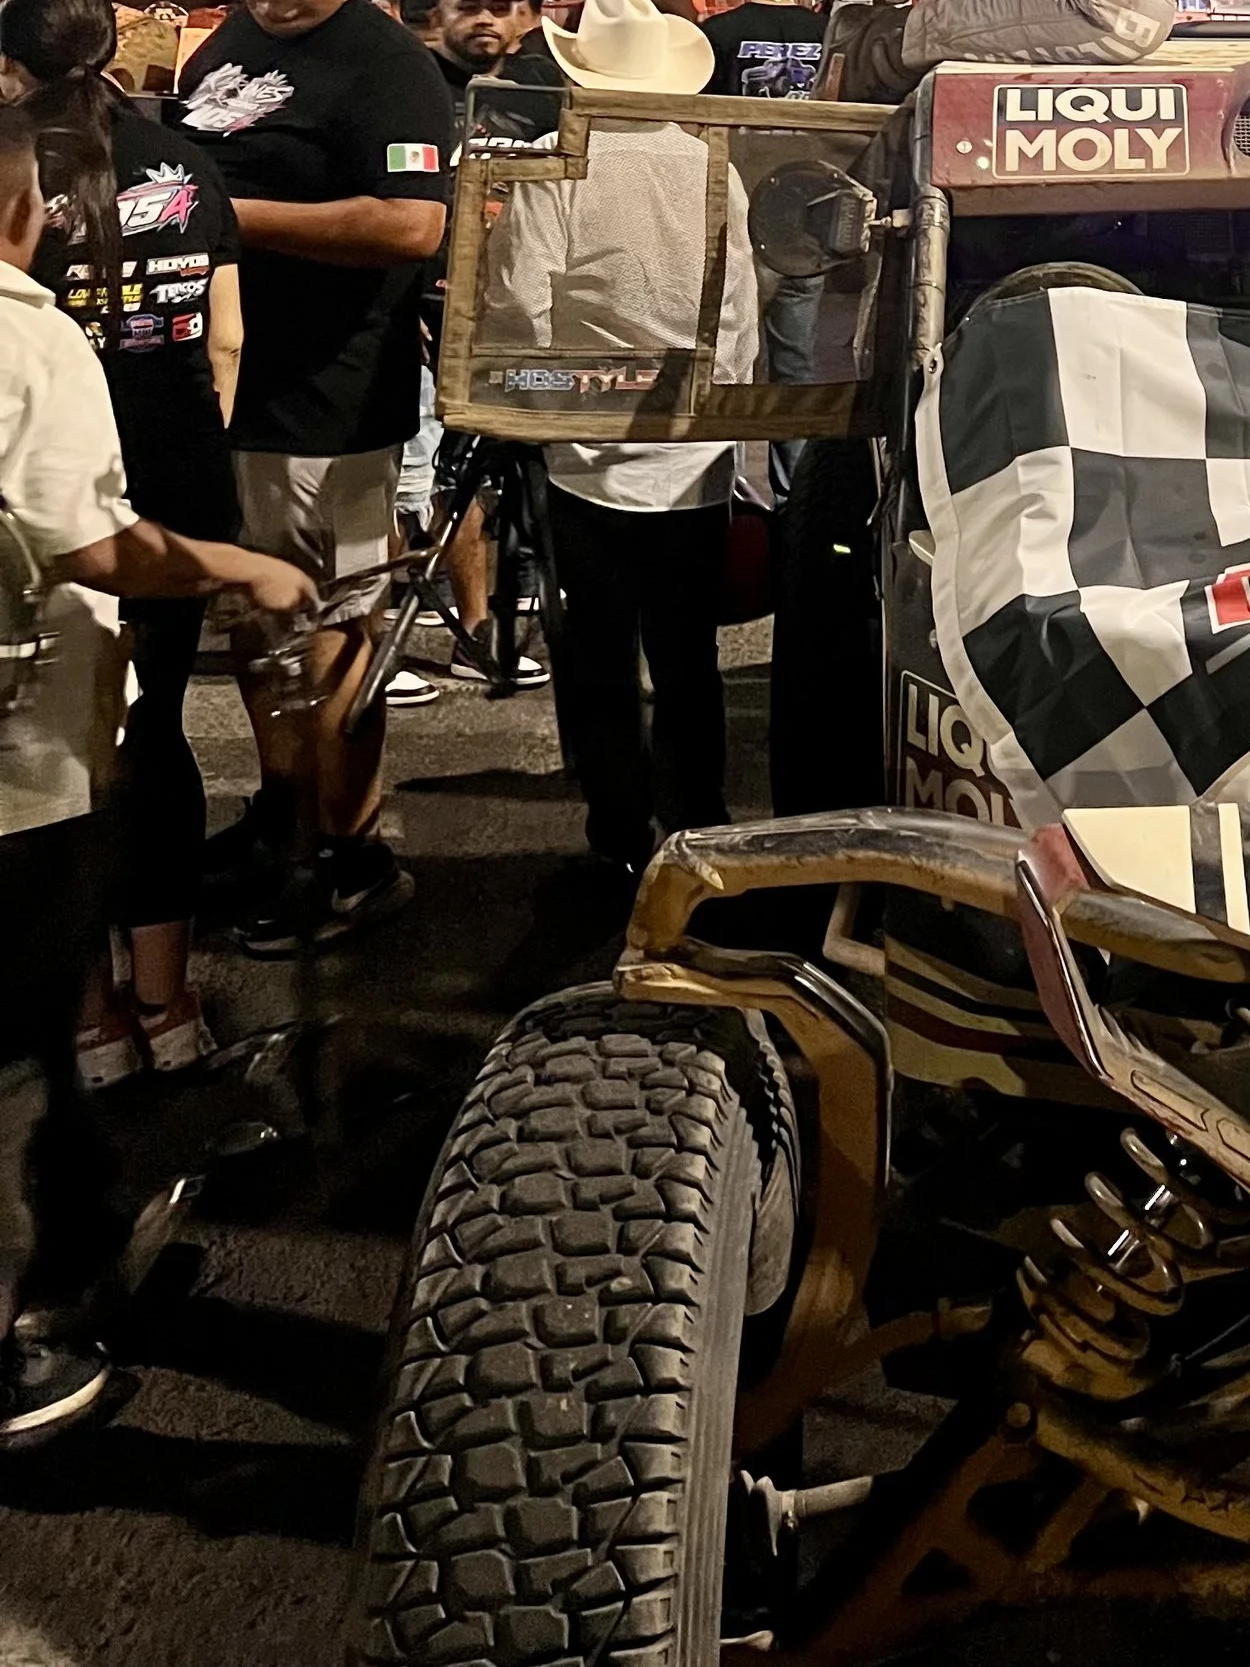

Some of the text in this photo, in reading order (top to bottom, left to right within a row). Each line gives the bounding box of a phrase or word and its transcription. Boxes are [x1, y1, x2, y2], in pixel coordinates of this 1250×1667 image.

[737, 41, 822, 60] PEREZ
[1005, 87, 1176, 123] LIQUI
[1005, 127, 1183, 172] MOLY
[906, 683, 985, 778] LIQ
